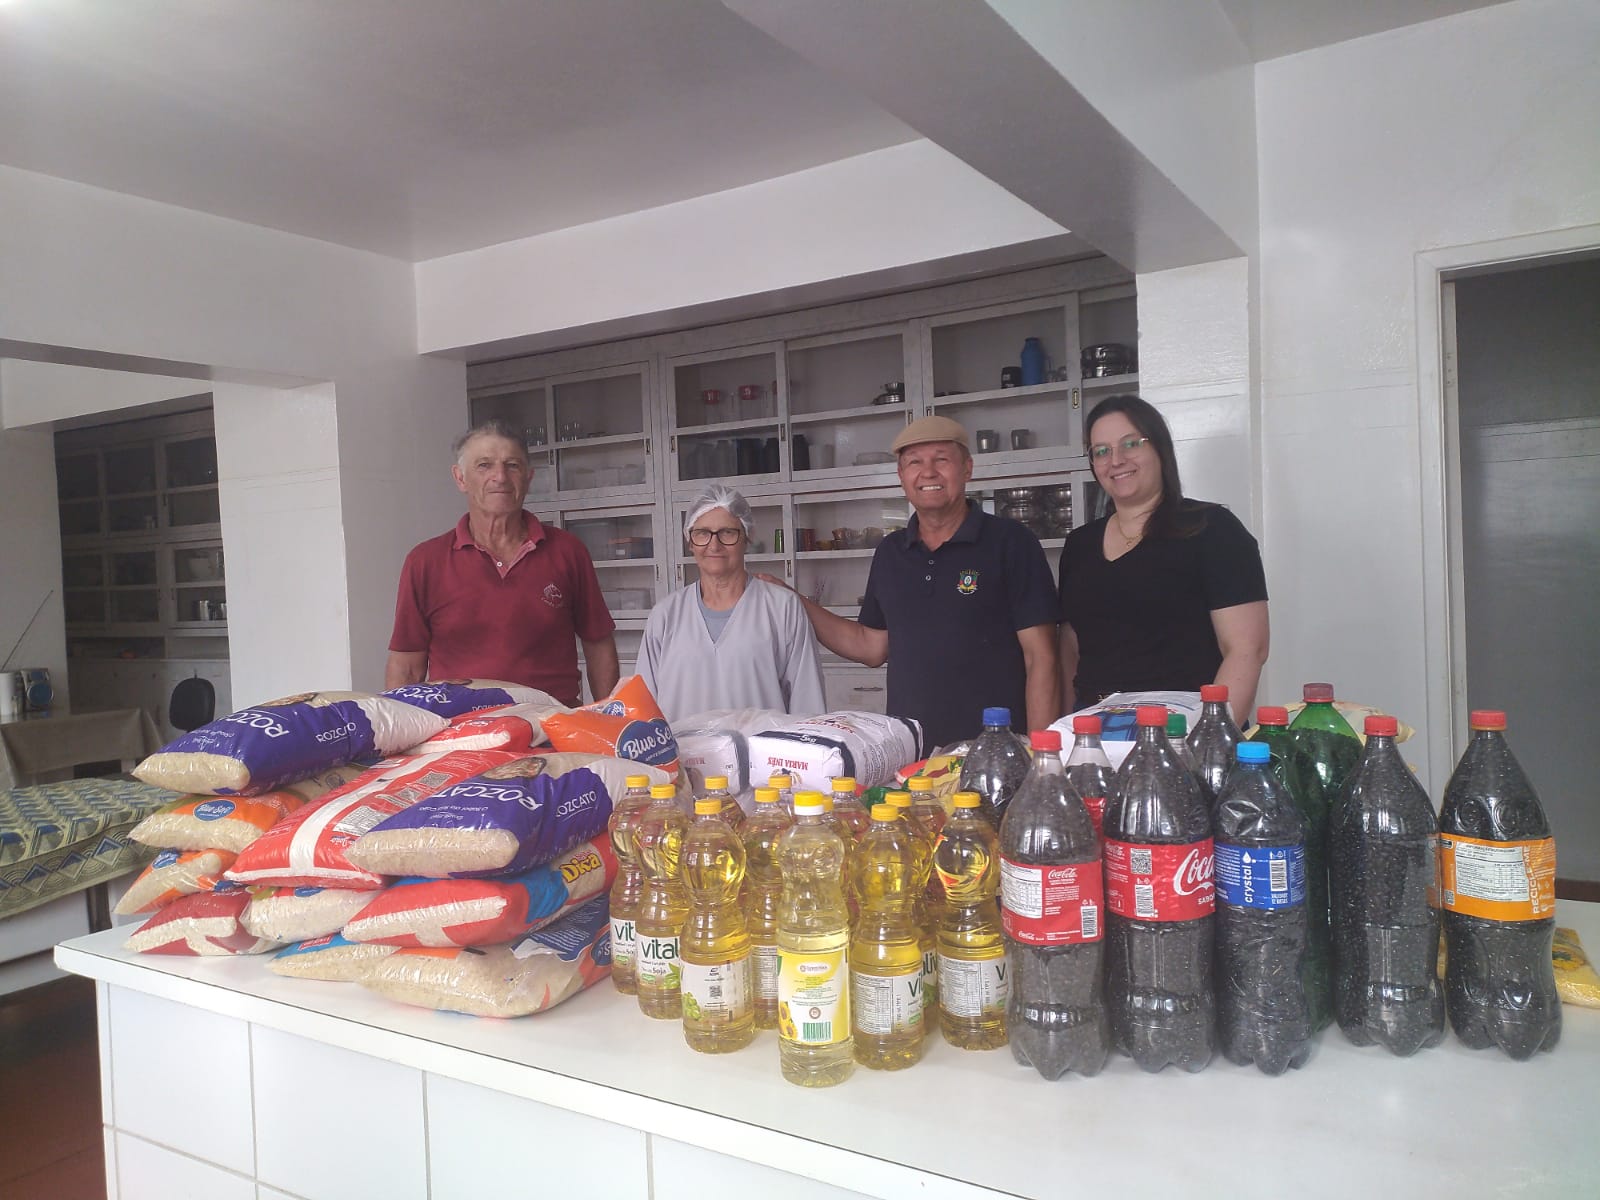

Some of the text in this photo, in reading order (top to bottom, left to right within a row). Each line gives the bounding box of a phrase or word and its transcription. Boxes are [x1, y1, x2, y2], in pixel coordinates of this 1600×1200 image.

[219, 712, 290, 738] ROZC
[315, 722, 357, 744] ROZCO
[623, 737, 657, 760] Blue
[784, 759, 809, 771] MARIA
[555, 790, 597, 818] OZCATO
[1241, 865, 1256, 903] crystal
